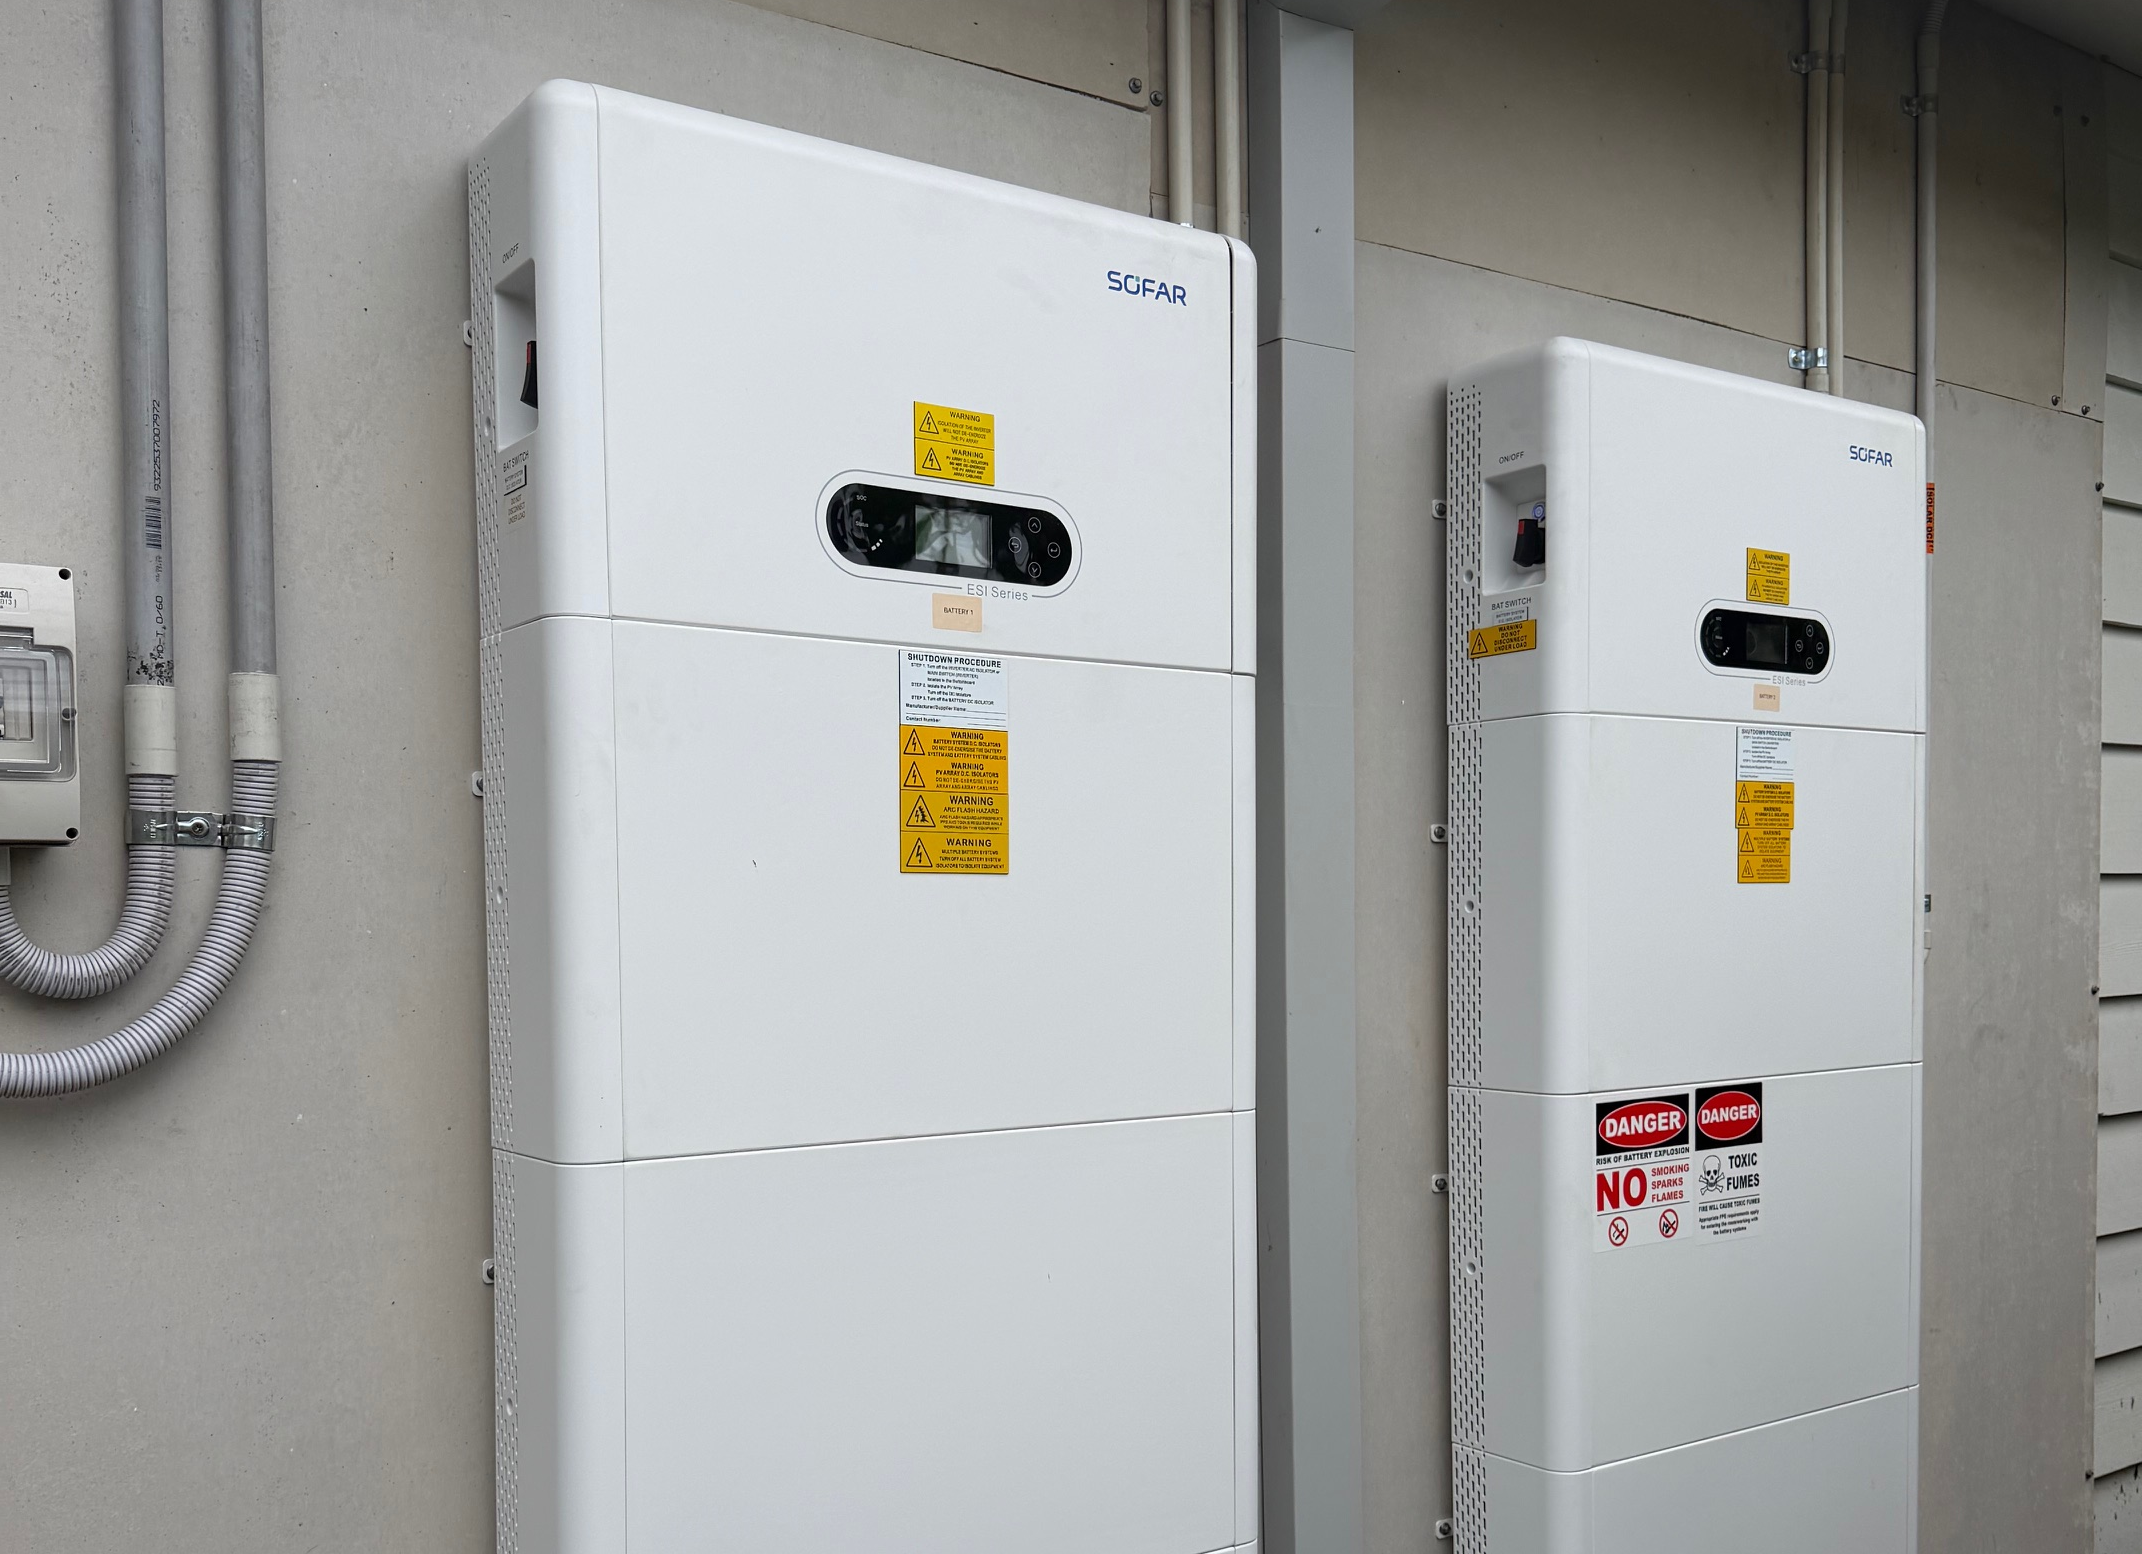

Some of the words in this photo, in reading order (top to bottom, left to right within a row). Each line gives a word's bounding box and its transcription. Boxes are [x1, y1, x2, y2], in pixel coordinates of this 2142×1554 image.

[1108, 271, 1186, 306] SOFAR
[950, 412, 980, 422] WARNING
[952, 449, 983, 459] WARNING
[1499, 451, 1524, 464] ON/OFF
[1850, 445, 1892, 467] SOFAR
[1926, 527, 1932, 539] DC
[968, 584, 987, 596] ESI
[991, 586, 1028, 600] Series
[1492, 602, 1503, 610] BAT
[1505, 597, 1531, 608] SWITCH
[1498, 624, 1522, 632] WARNING
[1494, 635, 1527, 646] DISCONNECT
[908, 653, 952, 663] SHUTDOWN
[955, 657, 1001, 668] PROCEDURE
[1773, 676, 1784, 684] ESI
[1786, 676, 1805, 686] Series
[951, 732, 984, 740] WARNING
[950, 795, 994, 806] WARNING
[946, 838, 992, 847] WARNING
[1701, 1104, 1757, 1125] DANGER
[1605, 1111, 1681, 1138] DANGER
[1596, 1156, 1612, 1166] RISK
[1614, 1155, 1621, 1163] OF
[1624, 1150, 1652, 1162] BATTERY
[1654, 1146, 1690, 1158] EXPLOSION
[1728, 1153, 1758, 1169] TOXIC
[1651, 1163, 1689, 1176] SMOKING
[1651, 1177, 1683, 1190] SPARKS
[1726, 1173, 1760, 1191] FUMES
[1597, 1167, 1647, 1212] NO
[1651, 1190, 1684, 1203] FLAMES
